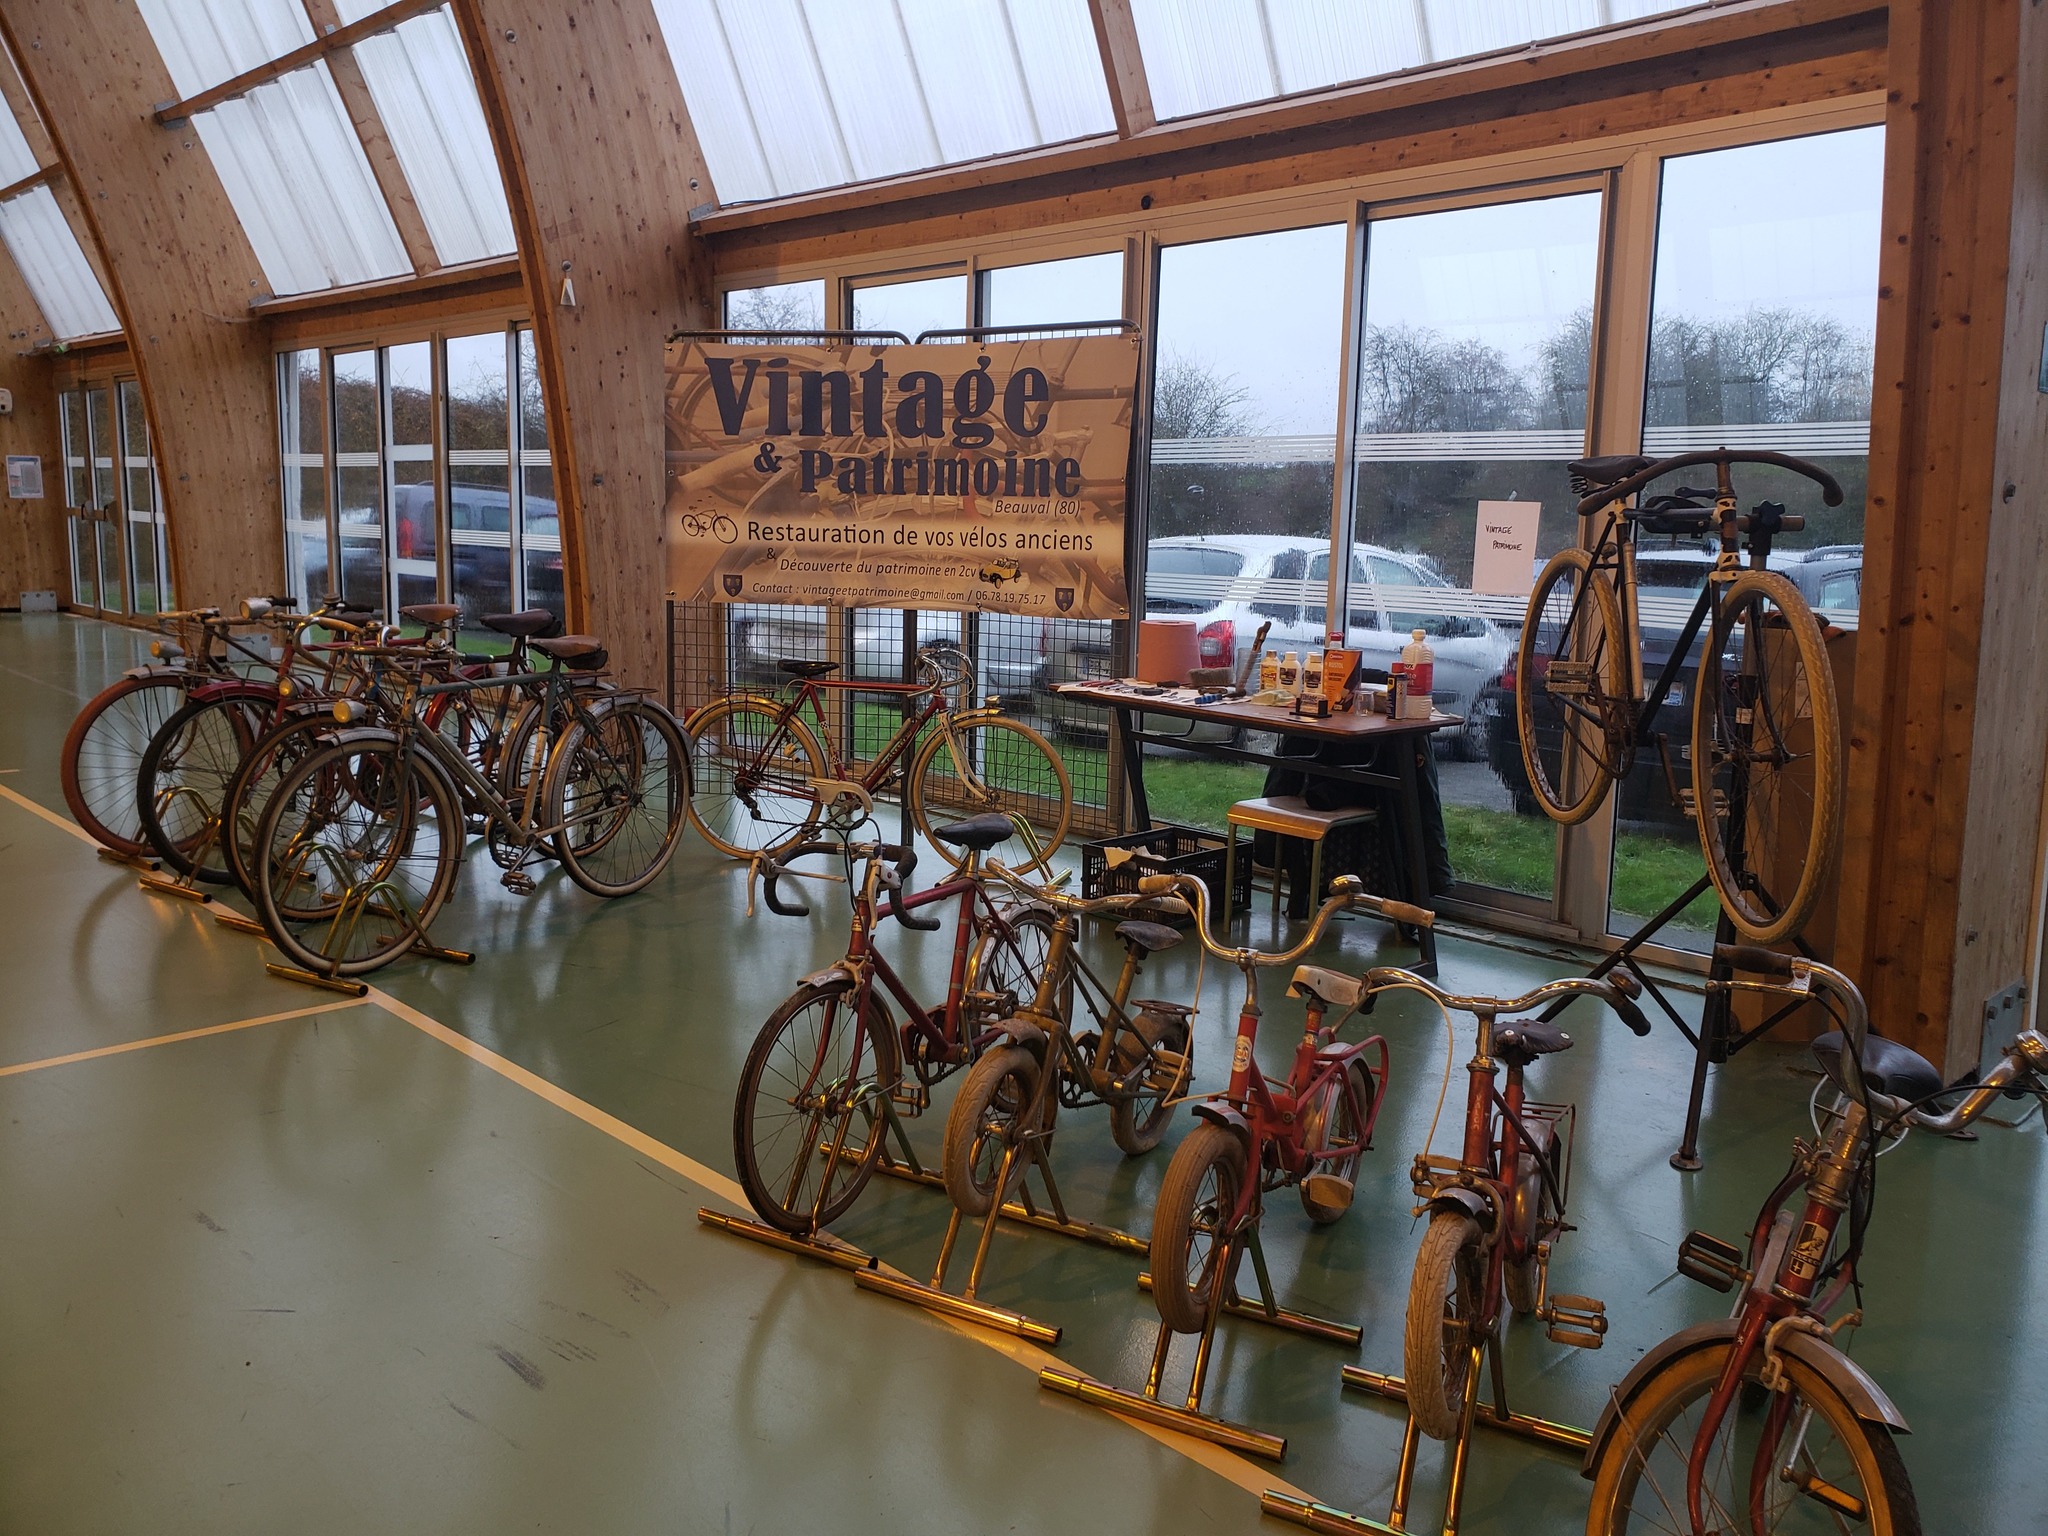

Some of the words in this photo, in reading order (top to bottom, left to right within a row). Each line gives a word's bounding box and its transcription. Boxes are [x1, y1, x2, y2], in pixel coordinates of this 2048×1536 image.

[704, 355, 1049, 449] Vintage
[753, 442, 784, 473] &
[799, 450, 1080, 498] Patrimoine
[995, 500, 1050, 514] Beauval
[1054, 500, 1081, 518] (80)
[748, 522, 884, 544] Restauration
[894, 524, 918, 545] de
[925, 530, 954, 546] vos
[960, 526, 1007, 548] vélos
[1016, 529, 1093, 551] anciens
[1486, 522, 1512, 534] VINTAGE
[766, 548, 776, 560] &
[780, 559, 853, 572] Découverte
[857, 561, 872, 573] du
[876, 563, 941, 576] patrimoine
[944, 567, 956, 576] en
[959, 565, 976, 577] 2cv
[752, 583, 792, 594] Contact
[803, 585, 964, 600] vintageetpatrimoine@gmail.com
[968, 590, 973, 601] /
[976, 590, 1046, 605] 06.78.19.75.17
